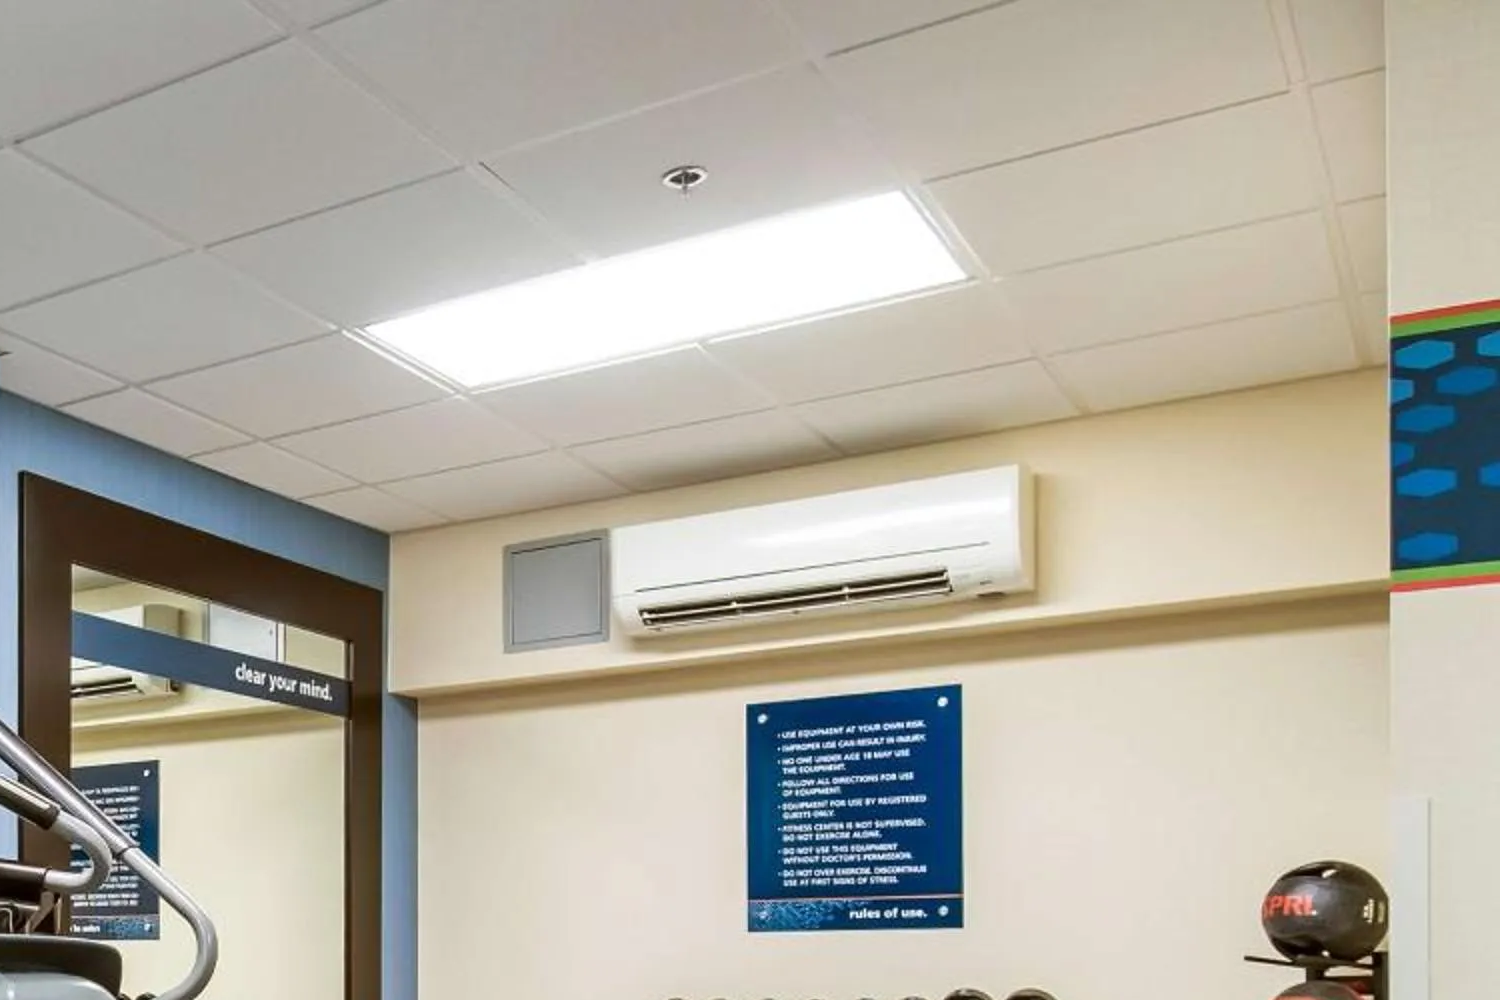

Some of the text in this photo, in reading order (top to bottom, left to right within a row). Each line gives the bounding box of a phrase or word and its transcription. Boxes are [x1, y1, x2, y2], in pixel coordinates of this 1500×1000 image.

[235, 662, 333, 701] clear your mind.
[798, 726, 844, 738] EQUIPMENT
[846, 725, 856, 734] AT
[857, 723, 880, 733] YOUR
[882, 721, 904, 731] OWN
[782, 742, 820, 752] IMPROPER
[822, 741, 836, 749] USE
[838, 739, 855, 748] CAN
[857, 737, 885, 747] RESULT
[886, 736, 895, 745] IN
[796, 756, 812, 765] ONE
[814, 754, 842, 763] UNDER
[844, 751, 860, 761] AGE
[873, 750, 892, 759] MAY
[893, 748, 910, 757] USE
[782, 766, 797, 775] THE
[782, 771, 914, 788] FOLLOW ALL DIRECTIONS FOR USE
[782, 789, 793, 797] OF
[782, 794, 927, 811] EQUIPMENT FOR USE BY REGISTERED
[782, 811, 811, 819] GUESTS
[782, 823, 812, 832] FITNESS
[814, 822, 844, 831] CENTER
[855, 820, 872, 829] NOT
[782, 834, 795, 842] DO
[796, 833, 812, 841] NOT
[815, 831, 851, 840] EXERCISE
[782, 842, 898, 855] DO NOT USE THIS EQUIPMENT
[782, 855, 819, 865] WITHOUT
[782, 869, 795, 877] DO
[796, 869, 812, 877] NOT
[814, 868, 835, 877] OVER
[874, 865, 927, 874] DISCONTINUE
[783, 879, 797, 887] USE
[811, 878, 831, 886] FIRST
[832, 877, 855, 885] SIGNS
[849, 907, 928, 919] rules of use.
